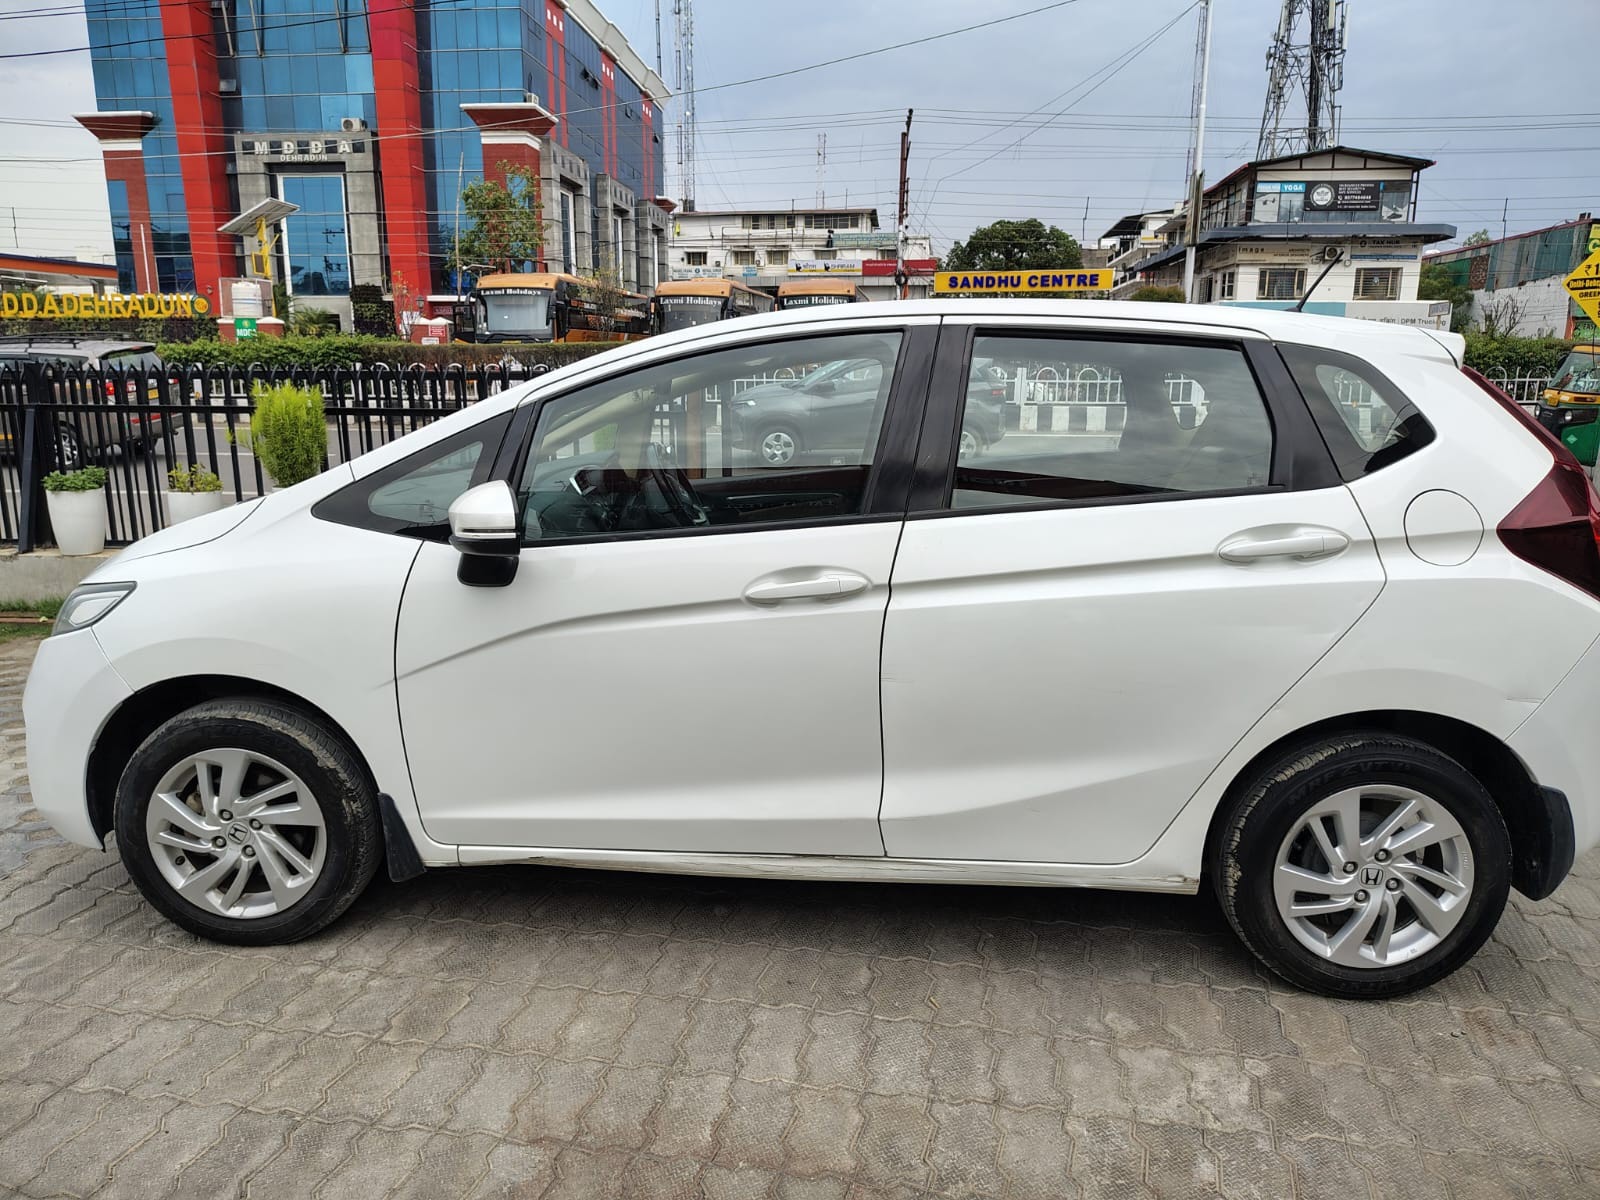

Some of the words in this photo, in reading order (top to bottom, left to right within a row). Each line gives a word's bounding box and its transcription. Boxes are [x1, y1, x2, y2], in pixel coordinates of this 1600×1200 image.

[280, 154, 328, 162] DEHRADUN
[948, 275, 1021, 289] SANDHU
[1027, 273, 1100, 288] CENTRE
[480, 288, 505, 296] Laxmi
[506, 288, 542, 296] Holidays
[62, 292, 194, 318] DEHRADUN
[660, 297, 684, 305] Laxmi
[686, 296, 722, 307] Holidays
[783, 297, 809, 306] Laxmi
[811, 296, 848, 305] Holidays
